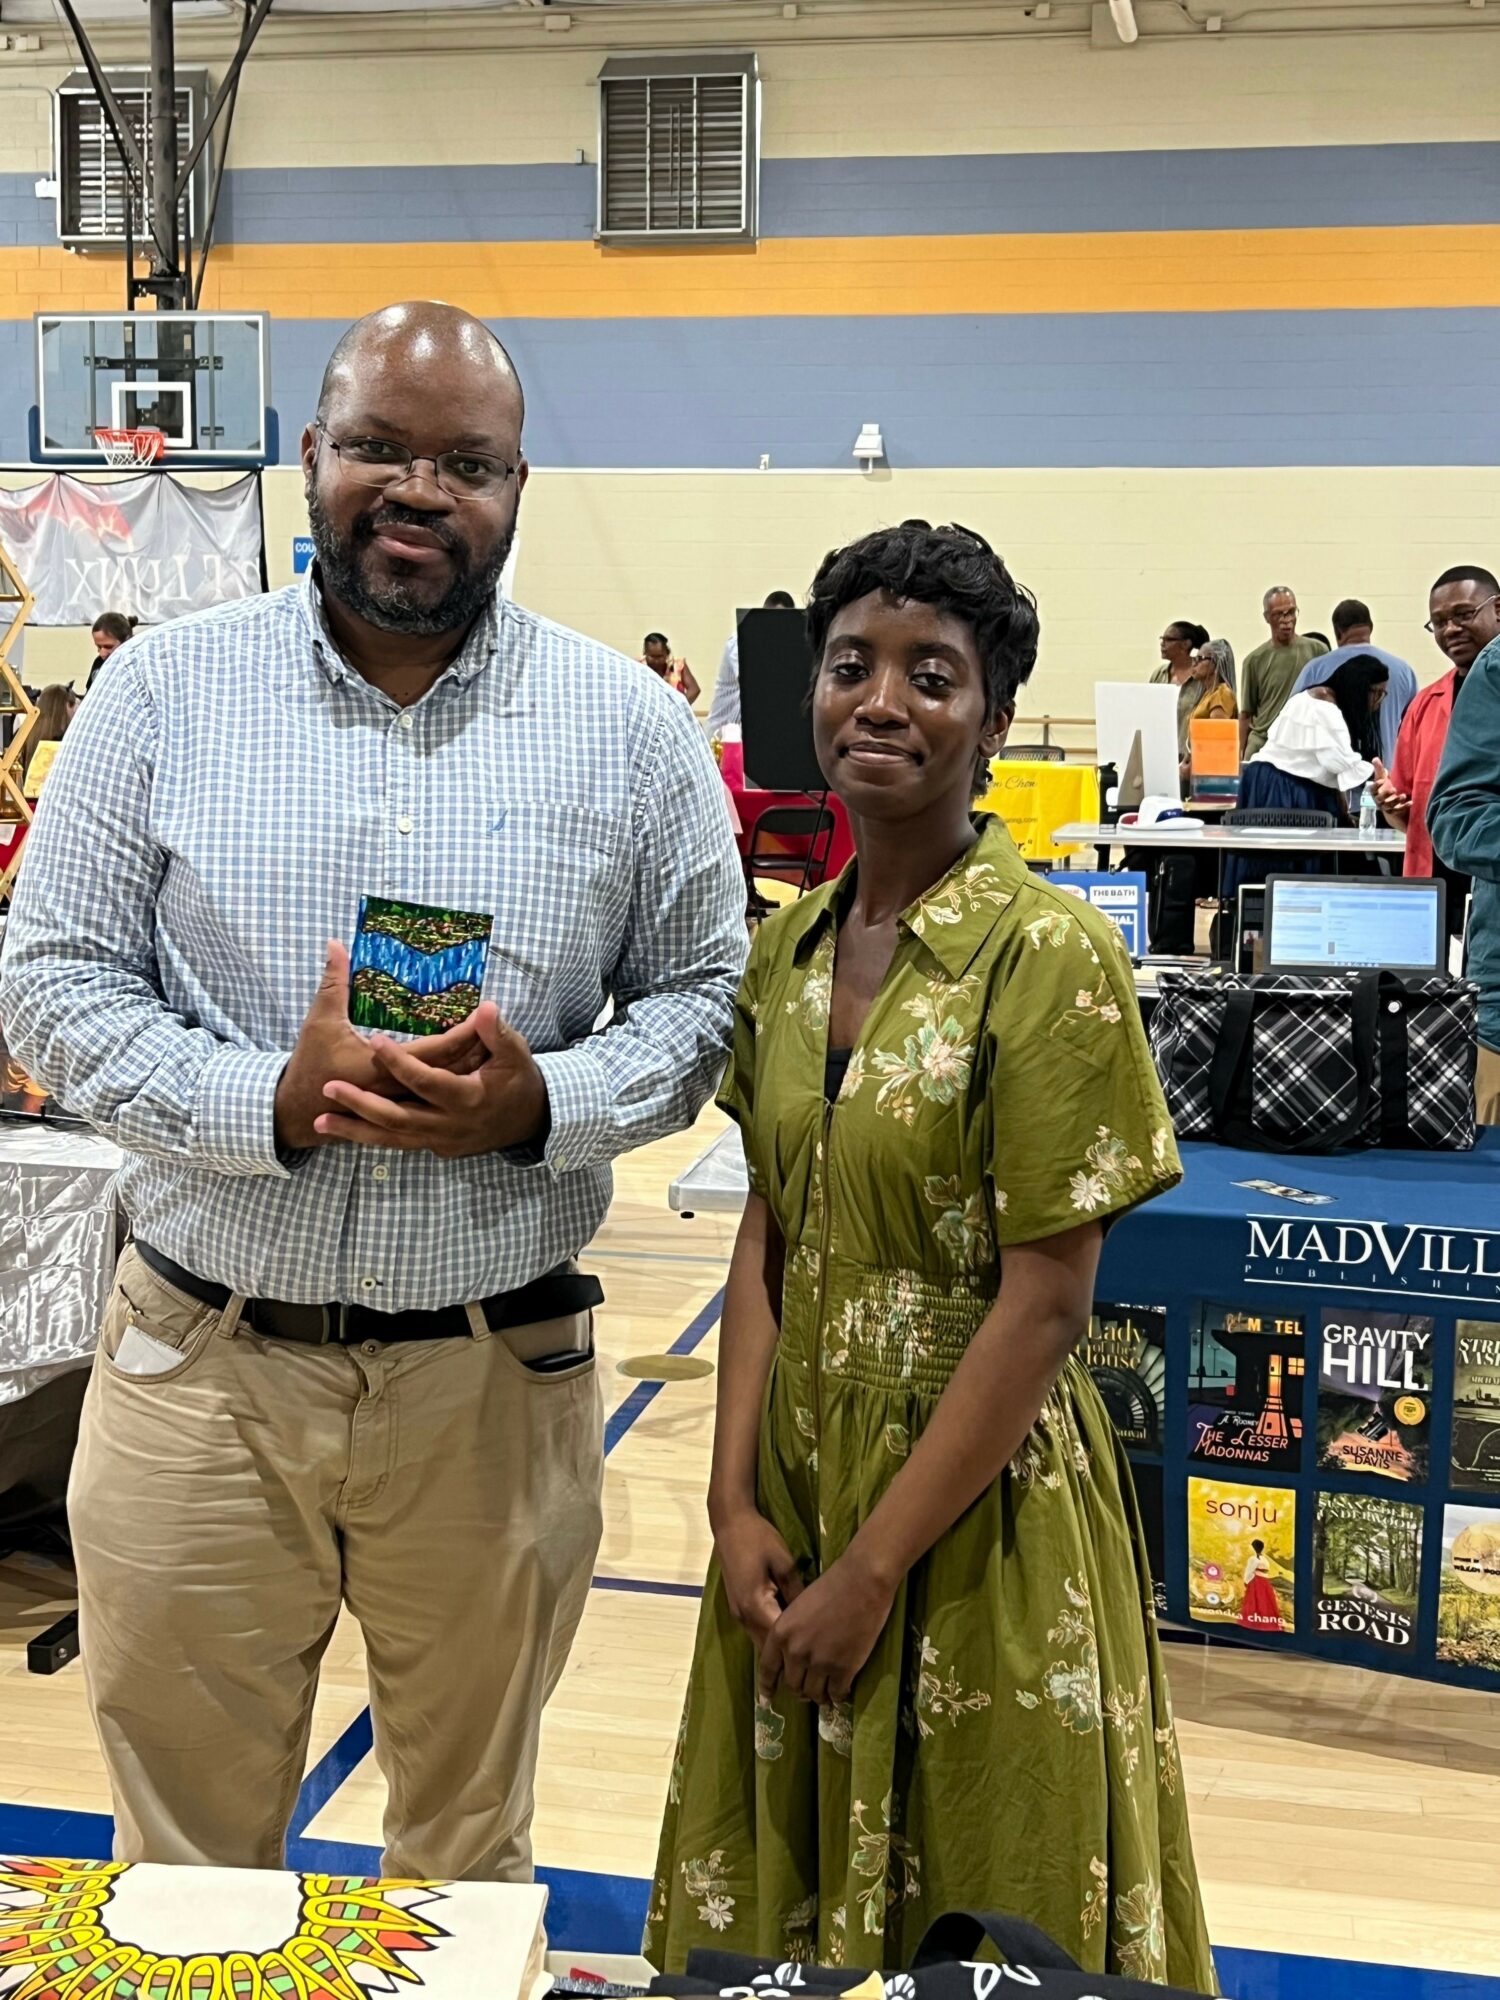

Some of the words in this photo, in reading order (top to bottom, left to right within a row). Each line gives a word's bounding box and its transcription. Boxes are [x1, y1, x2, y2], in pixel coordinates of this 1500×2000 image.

[1093, 889, 1109, 897] THE
[1110, 889, 1135, 897] BATH
[1087, 1315, 1146, 1344] Lady
[1322, 1323, 1431, 1350] GRAVITY
[1092, 1341, 1105, 1353] of
[1110, 1342, 1136, 1355] the
[1322, 1342, 1429, 1391] HILL
[1196, 1422, 1225, 1443] THE
[1230, 1428, 1289, 1449] LESSER
[1194, 1439, 1271, 1462] MADONNAS
[1342, 1445, 1403, 1463] SUSANNE
[1354, 1454, 1391, 1470] DAVIS
[1206, 1500, 1277, 1528] sonju
[1247, 1612, 1286, 1630] chang
[1317, 1599, 1412, 1627] GENESIS
[1317, 1613, 1410, 1645] ROAD
